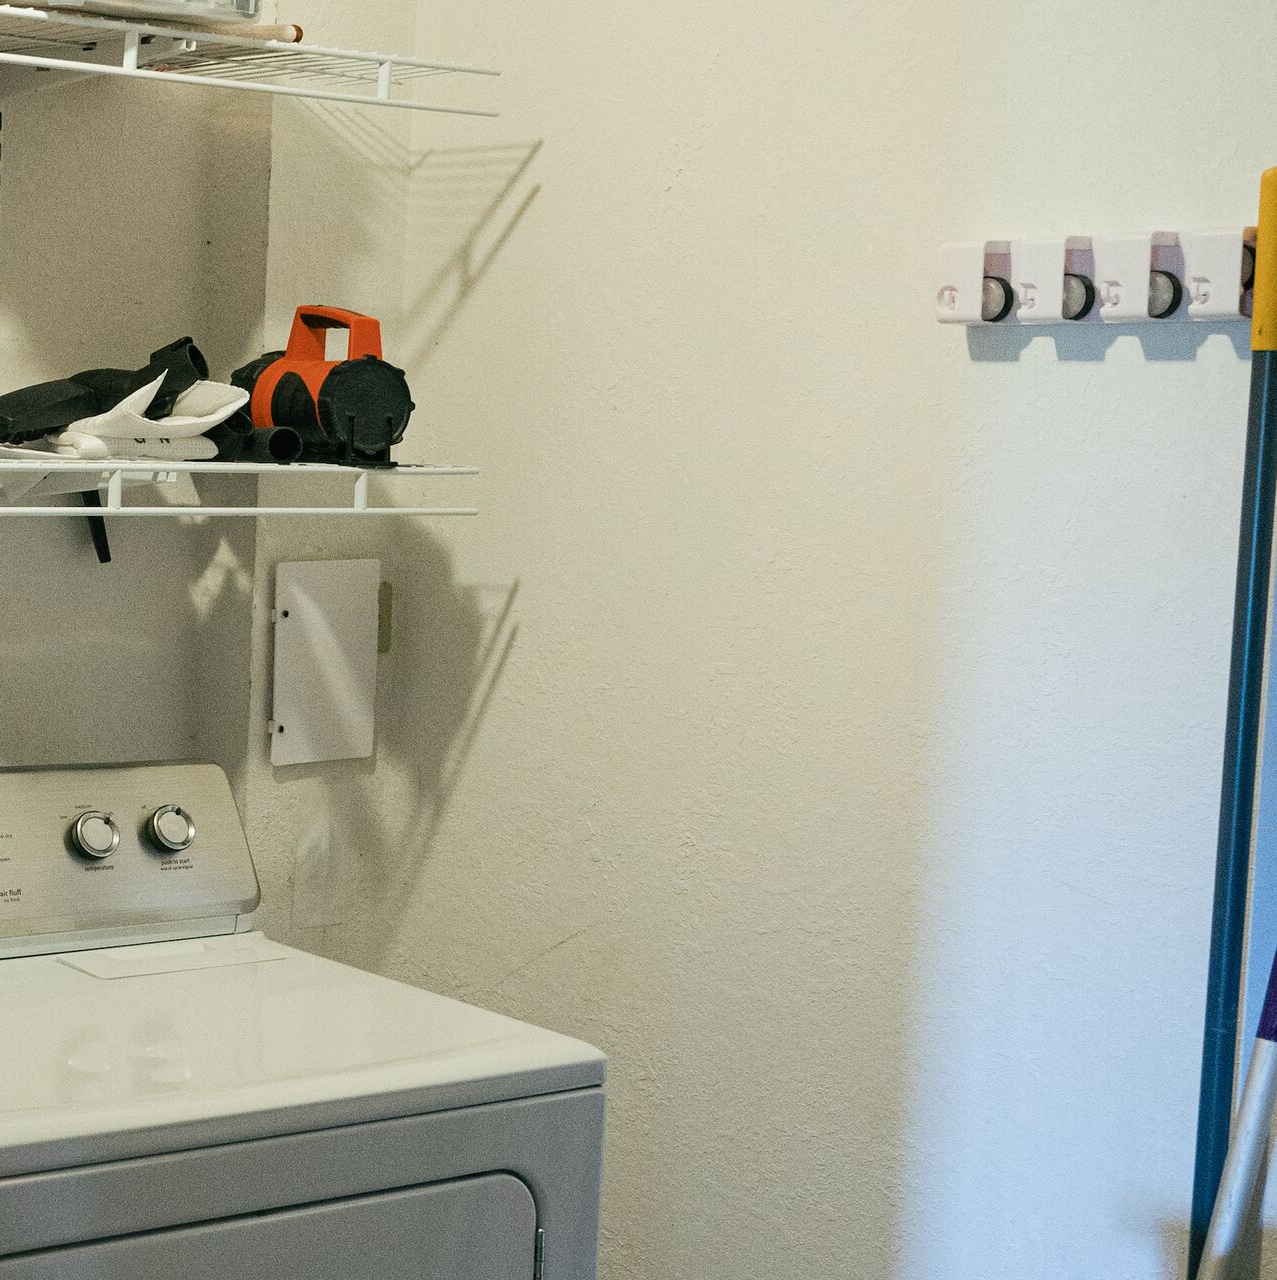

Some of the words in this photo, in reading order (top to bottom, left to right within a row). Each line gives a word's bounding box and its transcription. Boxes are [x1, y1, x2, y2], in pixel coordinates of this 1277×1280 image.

[161, 859, 173, 867] push
[84, 864, 114, 872] temperature
[0, 890, 8, 898] air
[9, 889, 22, 897] fluff
